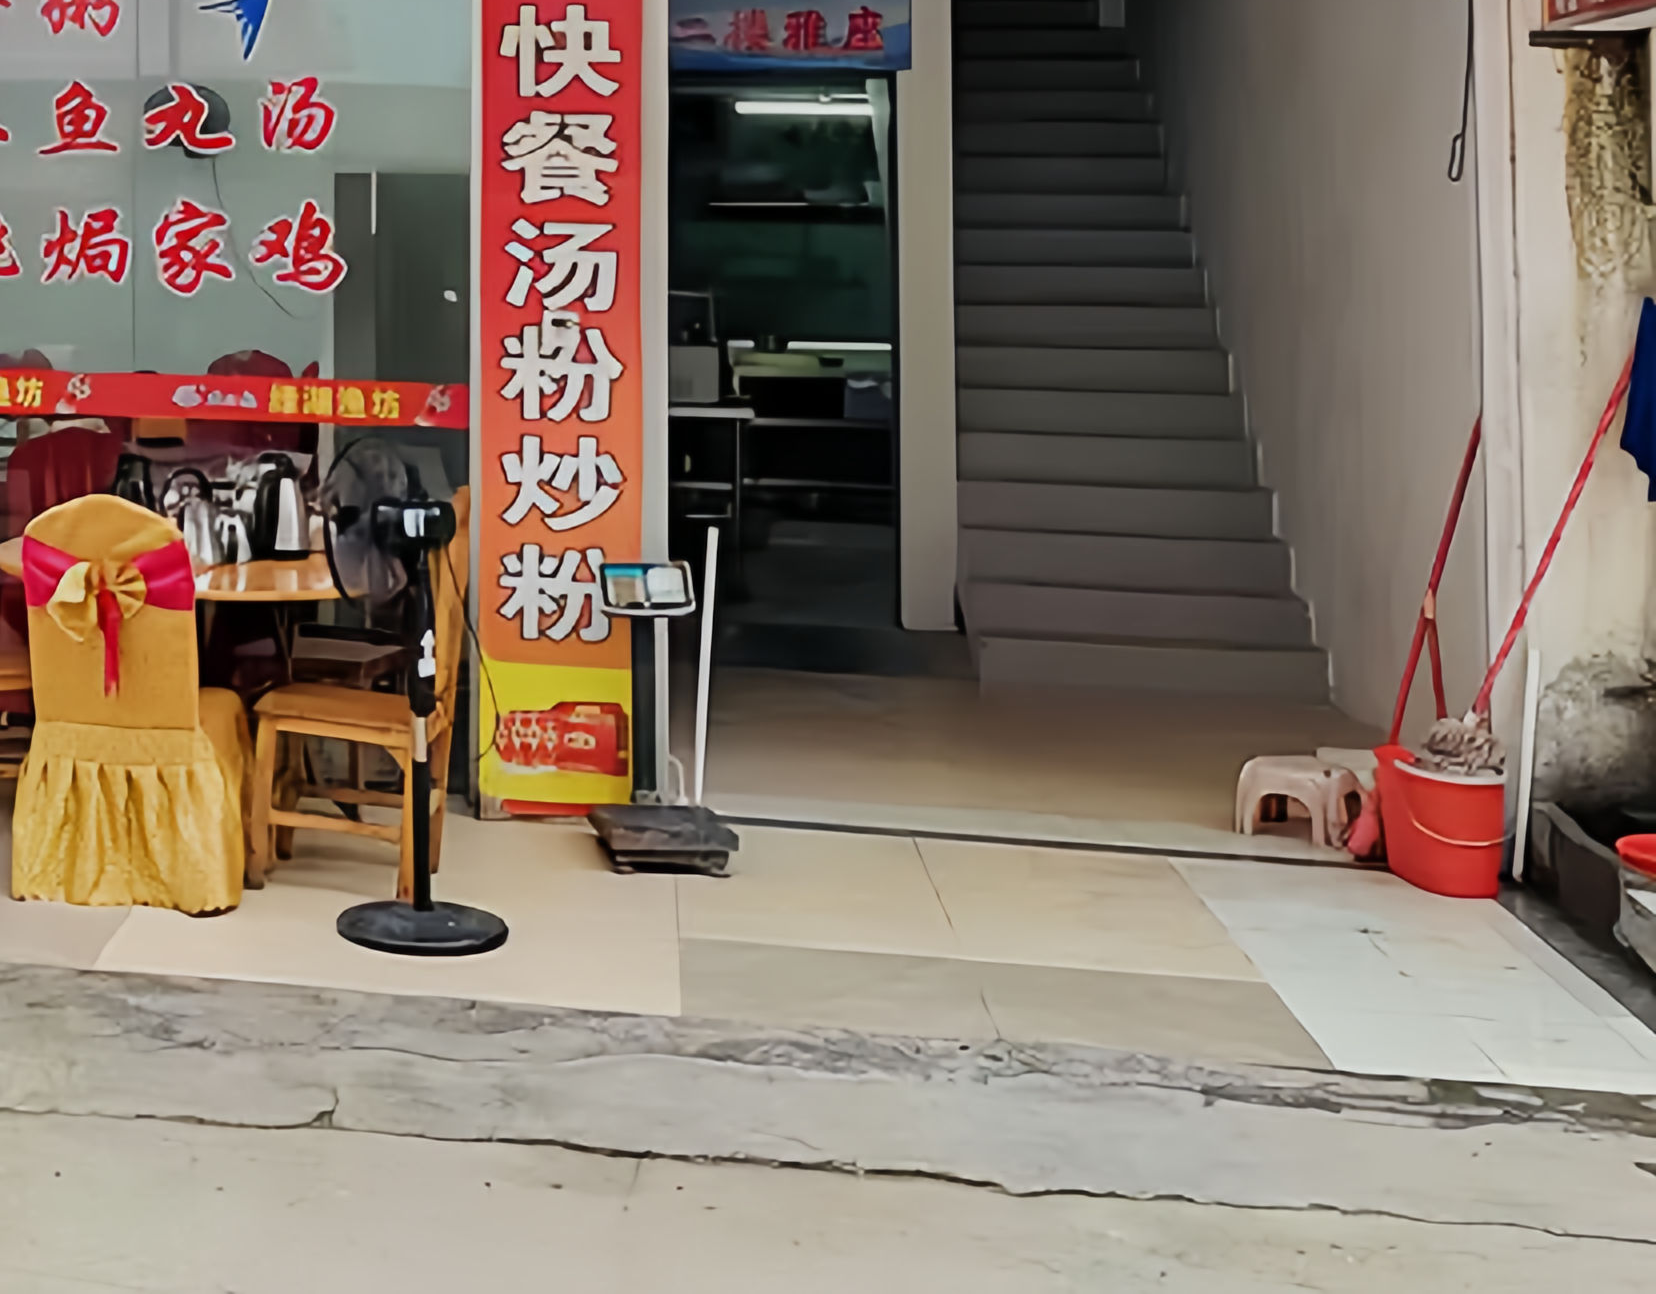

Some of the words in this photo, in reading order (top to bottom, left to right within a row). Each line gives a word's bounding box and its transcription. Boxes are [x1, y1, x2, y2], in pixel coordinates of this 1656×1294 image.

[499, 4, 625, 642] 快餐汤粉炒粉
